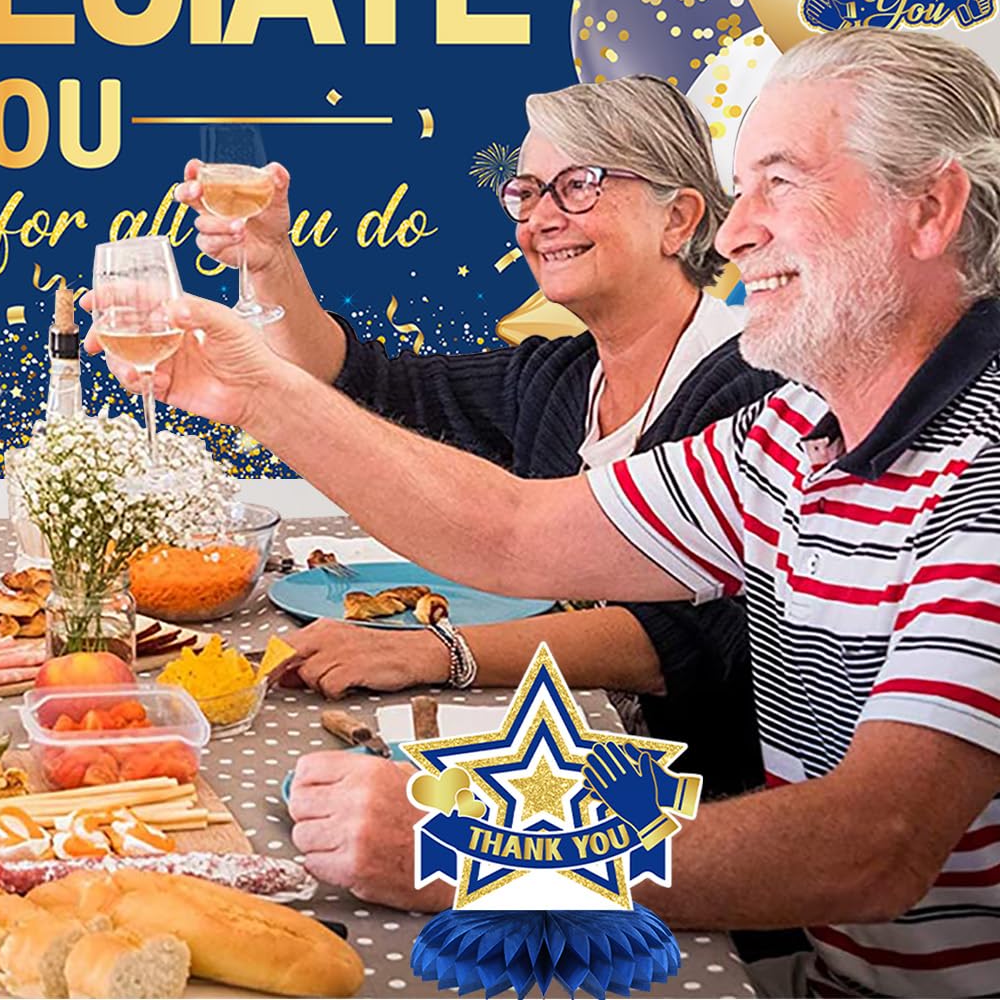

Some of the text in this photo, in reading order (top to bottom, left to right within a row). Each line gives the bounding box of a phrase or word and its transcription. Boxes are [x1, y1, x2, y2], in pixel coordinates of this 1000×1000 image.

[109, 181, 194, 248] all
[356, 182, 438, 249] do
[467, 824, 630, 862] THANK YOU
